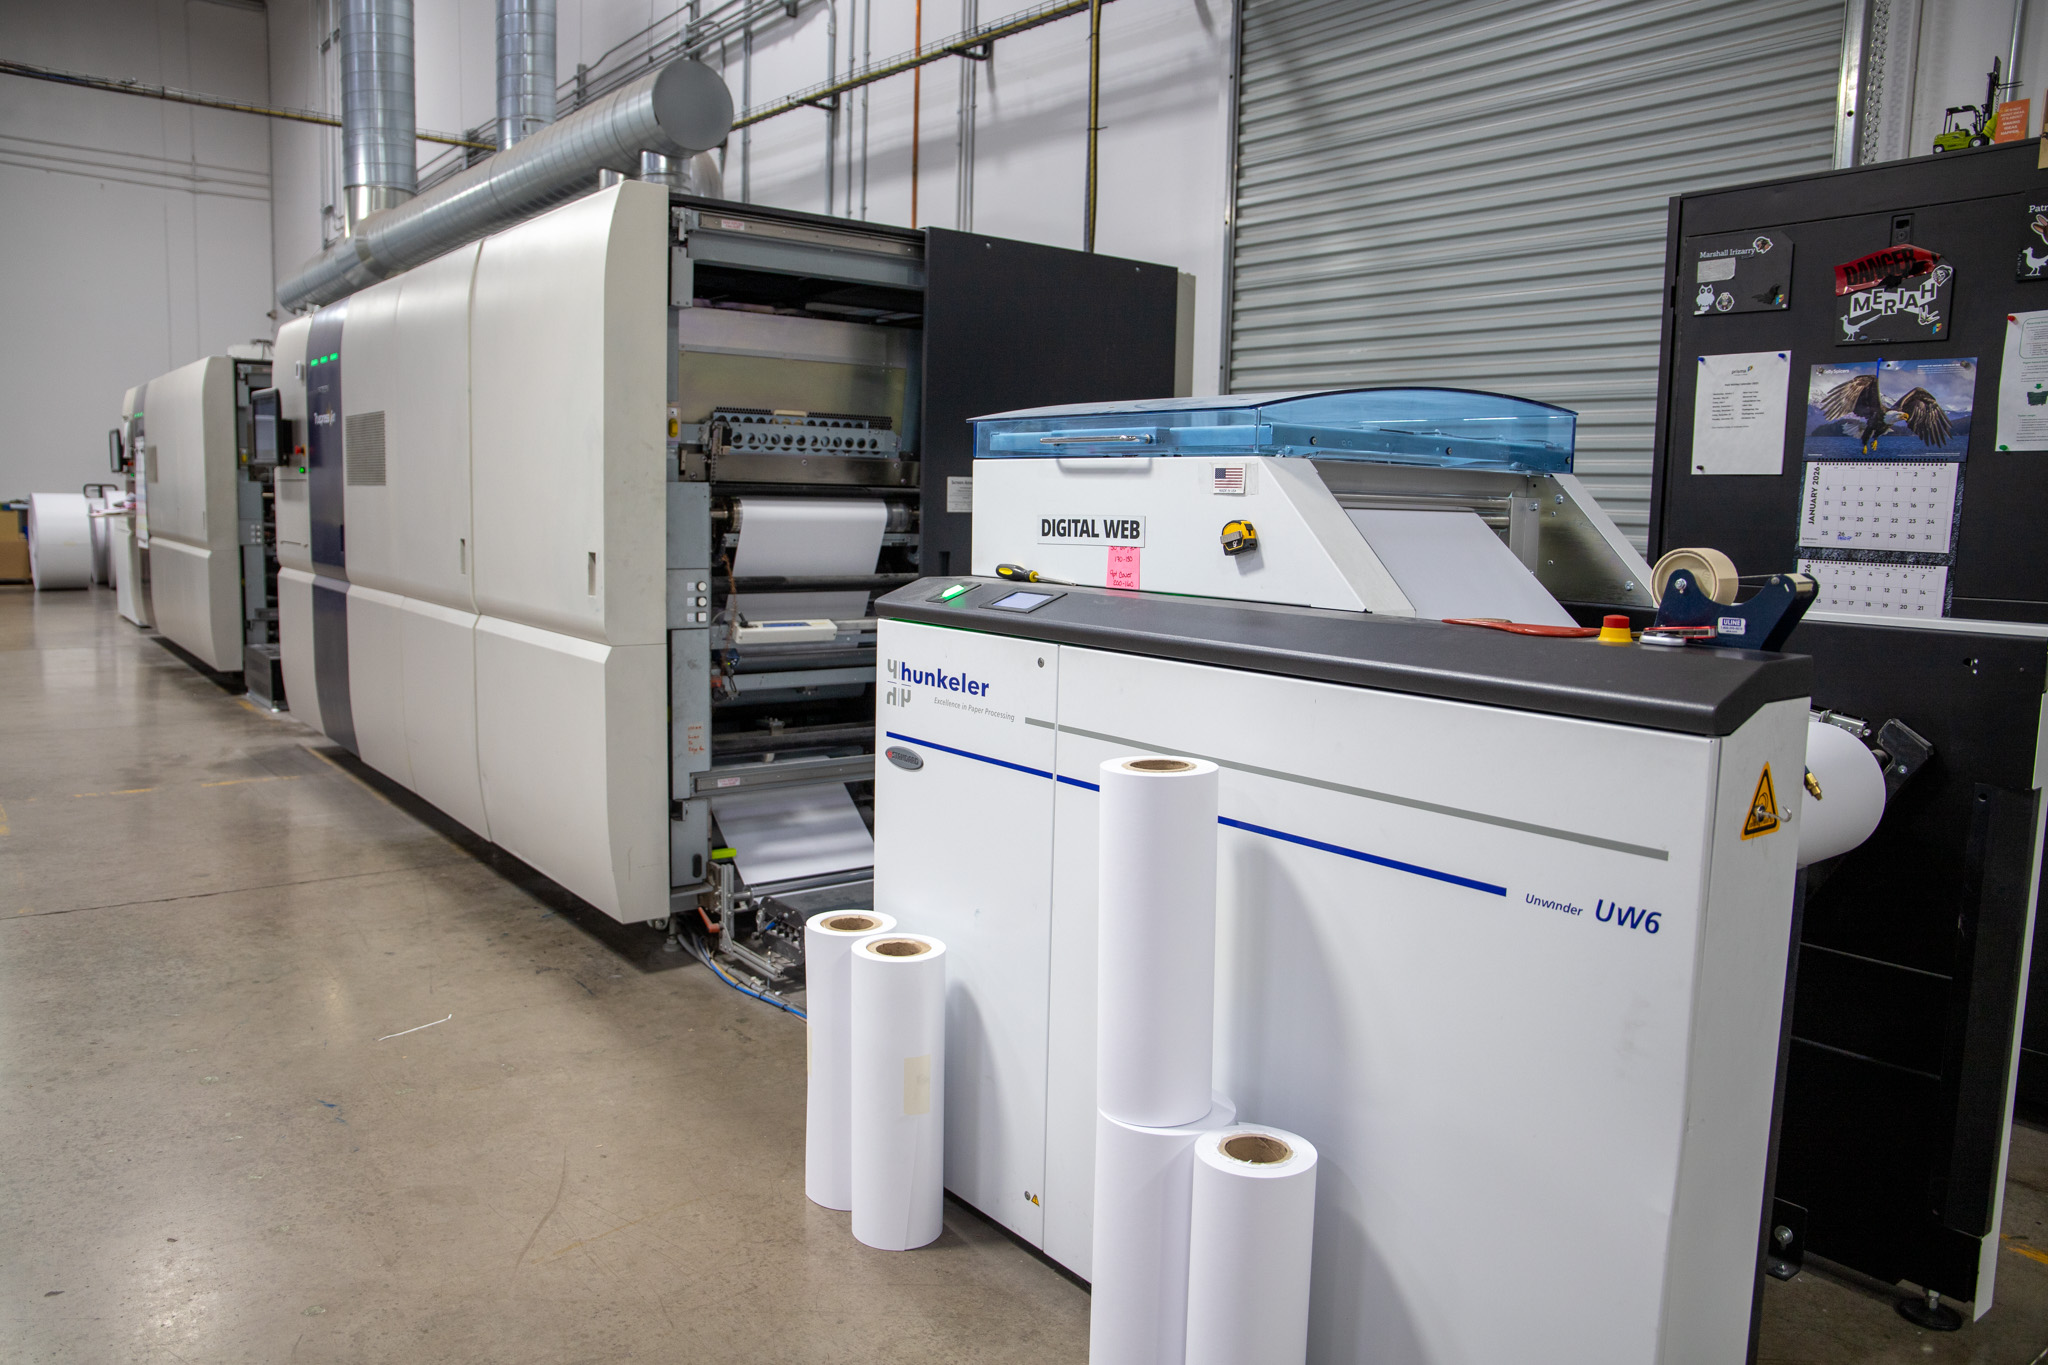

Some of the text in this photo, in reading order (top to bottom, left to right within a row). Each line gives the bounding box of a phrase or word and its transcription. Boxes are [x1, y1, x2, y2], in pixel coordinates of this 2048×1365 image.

[1700, 248, 1755, 258] Marshall Irizarry
[1843, 247, 1916, 285] DANGER
[1853, 283, 1936, 314] MERIAH
[1808, 487, 1818, 525] JANUARY
[1813, 466, 1821, 485] 2026
[1041, 518, 1140, 539] DIGITAL WEB
[901, 662, 989, 697] hunkeler
[934, 697, 1015, 722] Excellence in Paper Processing
[1525, 893, 1662, 934] Unwinder UW6
